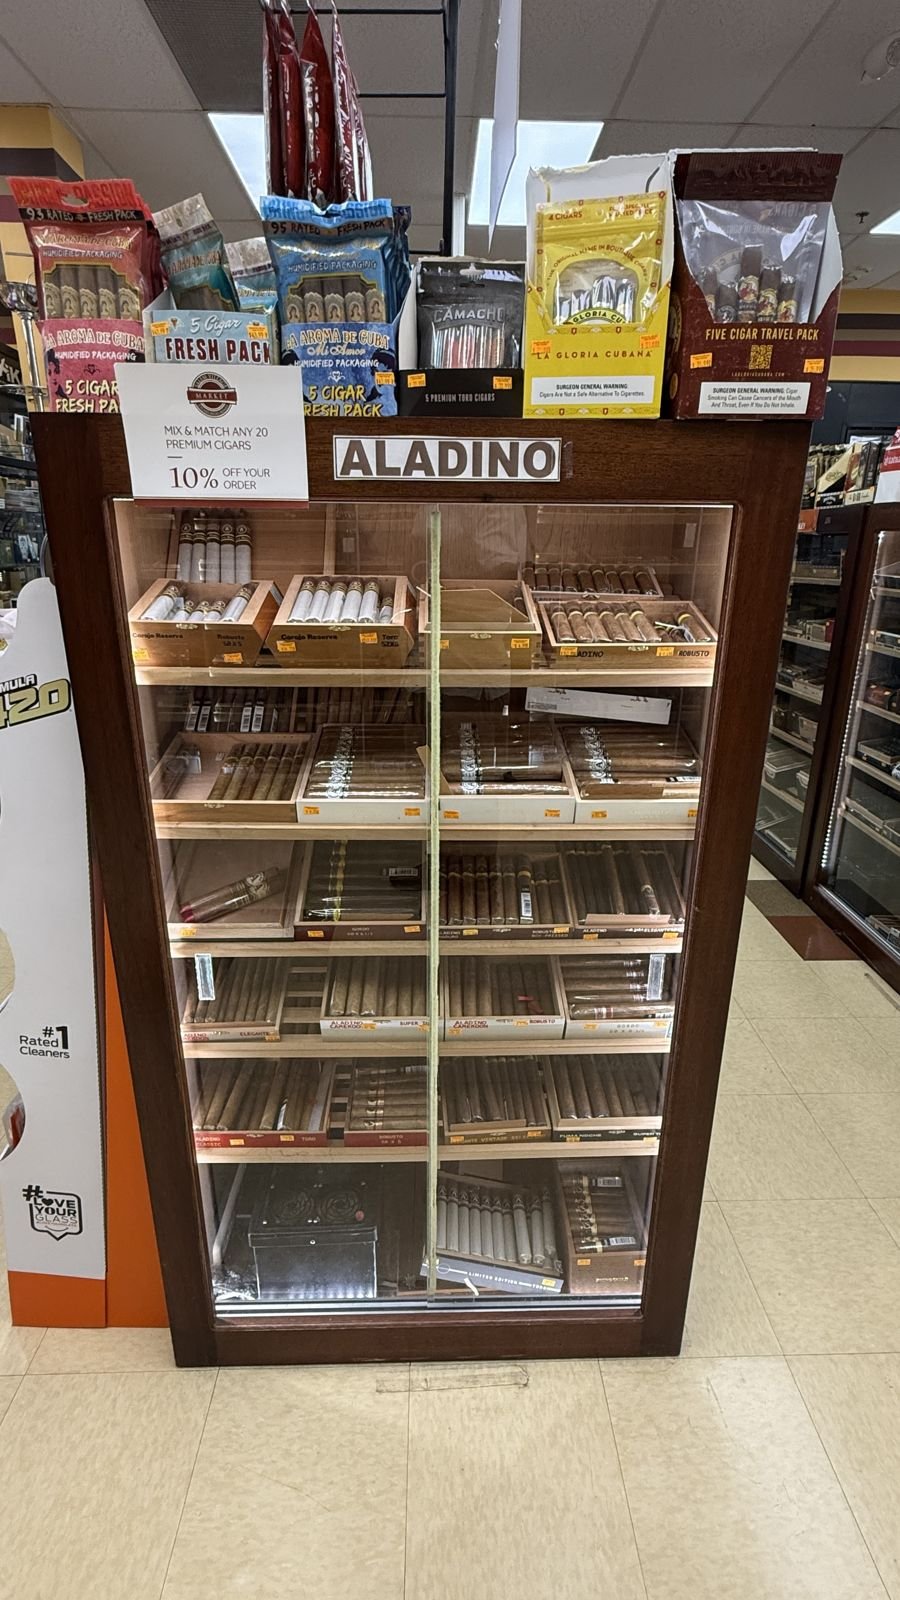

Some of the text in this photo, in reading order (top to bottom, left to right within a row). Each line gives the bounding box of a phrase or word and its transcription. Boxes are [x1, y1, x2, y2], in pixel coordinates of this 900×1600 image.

[27, 208, 137, 223] 93 RATED FRESH PACK
[555, 211, 583, 221] CIGARS
[271, 218, 386, 236] 95 RATED FRESH PACK
[81, 250, 123, 259] PACKAGING
[288, 260, 329, 273] HUMIDIFIED
[331, 259, 377, 271] PACKAGING
[433, 307, 506, 323] CAMACHO
[572, 310, 624, 324] GLORIA CU
[190, 314, 242, 337] 5 Cigar
[57, 327, 96, 346] AROMA
[95, 330, 112, 345] DE
[111, 330, 145, 352] CUBA
[299, 328, 342, 346] AROMA
[342, 330, 358, 344] DE
[358, 329, 390, 350] CUBA
[705, 327, 819, 341] FIVE CIGAR TRAVEL PACK
[55, 351, 137, 361] HUMIDIFIED PACKAGING
[165, 338, 271, 363] FRESH PACK
[306, 342, 366, 357] Mi Amor
[537, 350, 652, 360] LA GLORIA CUBANA
[294, 358, 380, 368] HUMIDIFIED PACKAGING
[65, 379, 119, 397] 5 CIGAR
[309, 385, 367, 402] 5 CIGAR
[195, 392, 228, 400] MARKET
[425, 393, 496, 402] 5 PREMIUM TORO CIGARS
[55, 398, 119, 413] FRESH PA
[303, 403, 382, 417] RESH PACK
[164, 425, 268, 438] MIX & MATCH ANY 20
[165, 439, 252, 450] PREMIUM CIGARS
[339, 439, 556, 479] ALADINO
[169, 466, 219, 489] 10%
[222, 467, 271, 478] OFF YOUR
[223, 480, 257, 490] ORDER
[576, 650, 604, 658] ADINO
[0, 674, 36, 694] MULA
[19, 1035, 59, 1048] Rated
[19, 1046, 71, 1059] Cleaners
[34, 1205, 77, 1217] YOUR
[35, 1213, 78, 1225] GLASS
